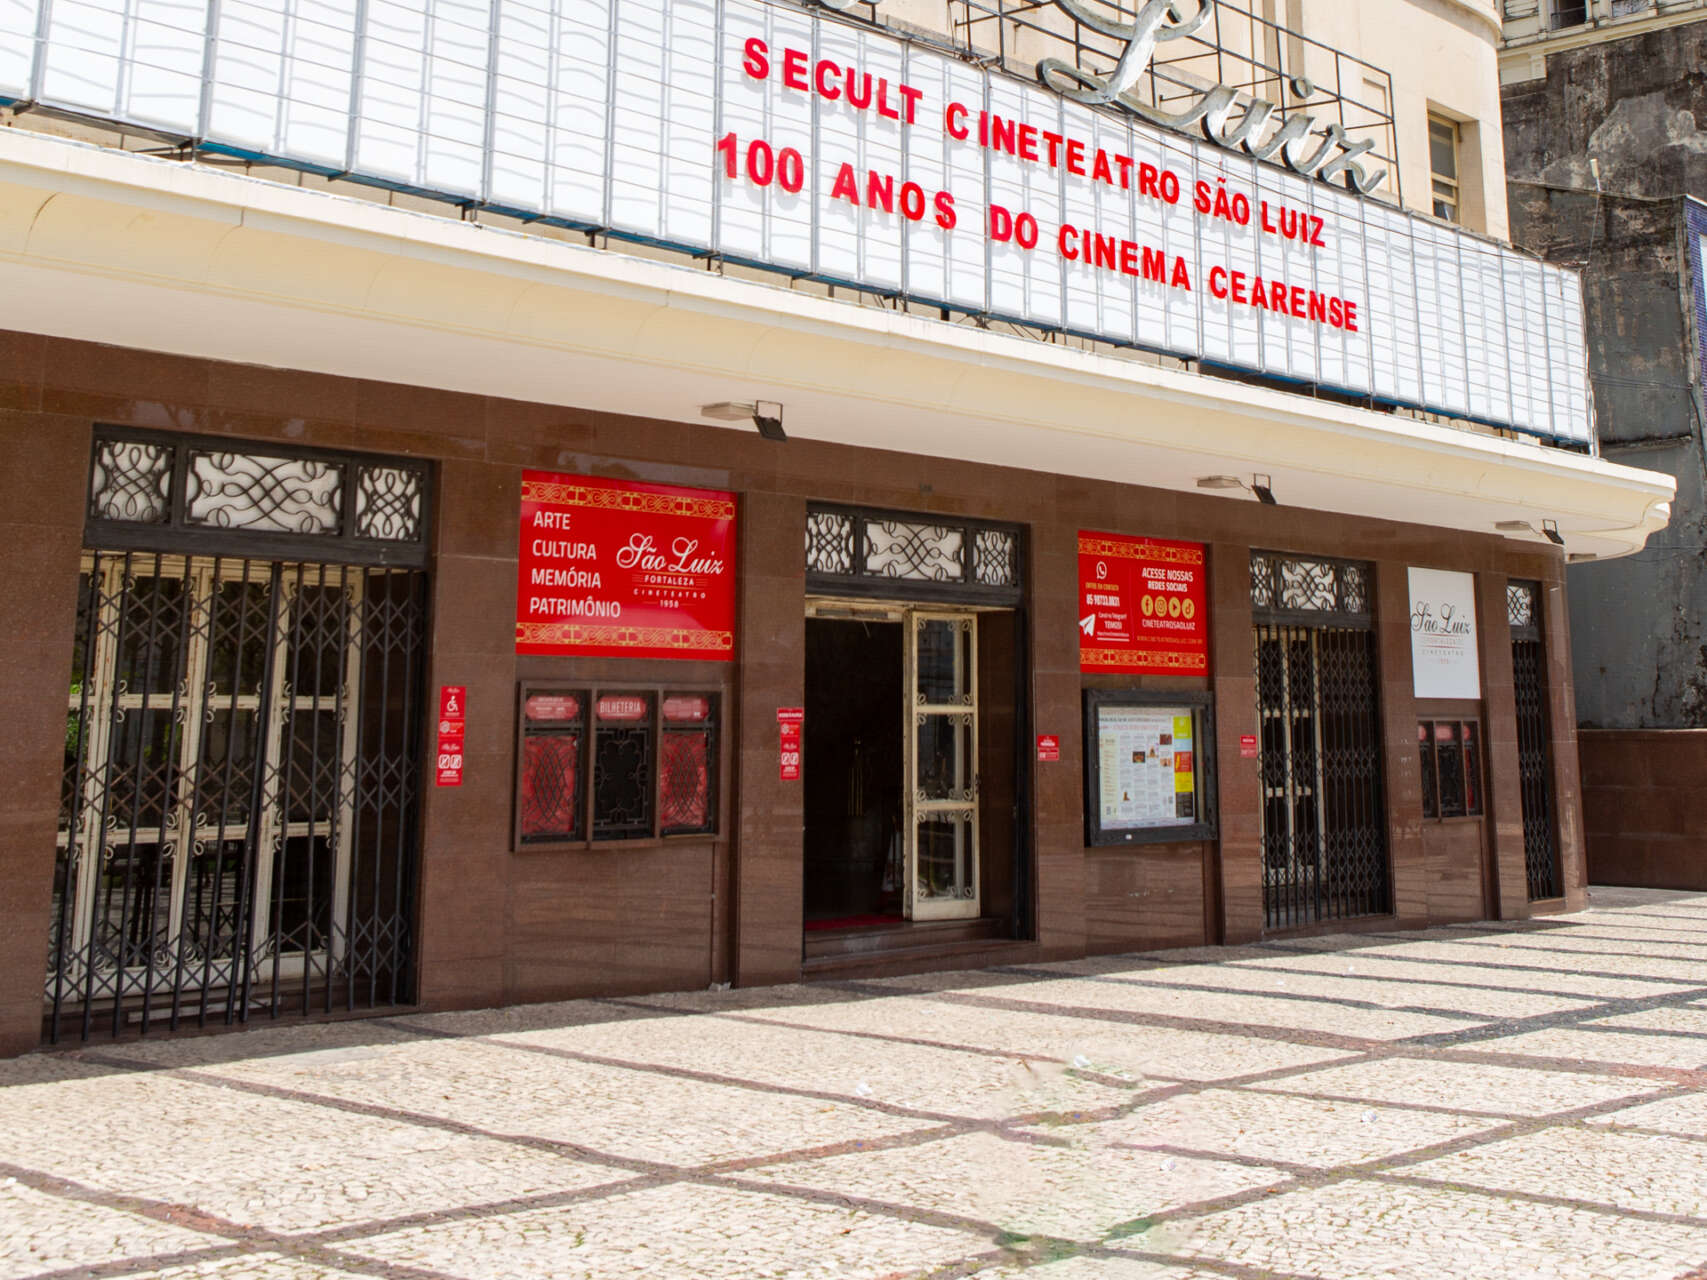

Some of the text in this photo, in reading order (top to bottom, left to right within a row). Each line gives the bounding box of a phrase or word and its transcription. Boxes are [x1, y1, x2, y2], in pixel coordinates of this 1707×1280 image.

[743, 37, 1326, 247] SECULT CINETEATRO SÃO LUIZ
[717, 131, 1359, 332] 100 ANOS DO CINEMA CEARENSE
[533, 511, 571, 530] ARTE
[532, 539, 597, 560] CULTURA
[616, 532, 724, 575] São Luiz
[531, 566, 601, 588] MEMÓRIA
[644, 575, 694, 586] FORTALEZA
[1142, 567, 1194, 582] ACESSE NOSSAS
[633, 588, 706, 599] CINETEATRO
[529, 596, 621, 618] PATRIMÔNIO
[1411, 601, 1472, 634] São Luiz
[600, 701, 641, 713] BILHETERIA
